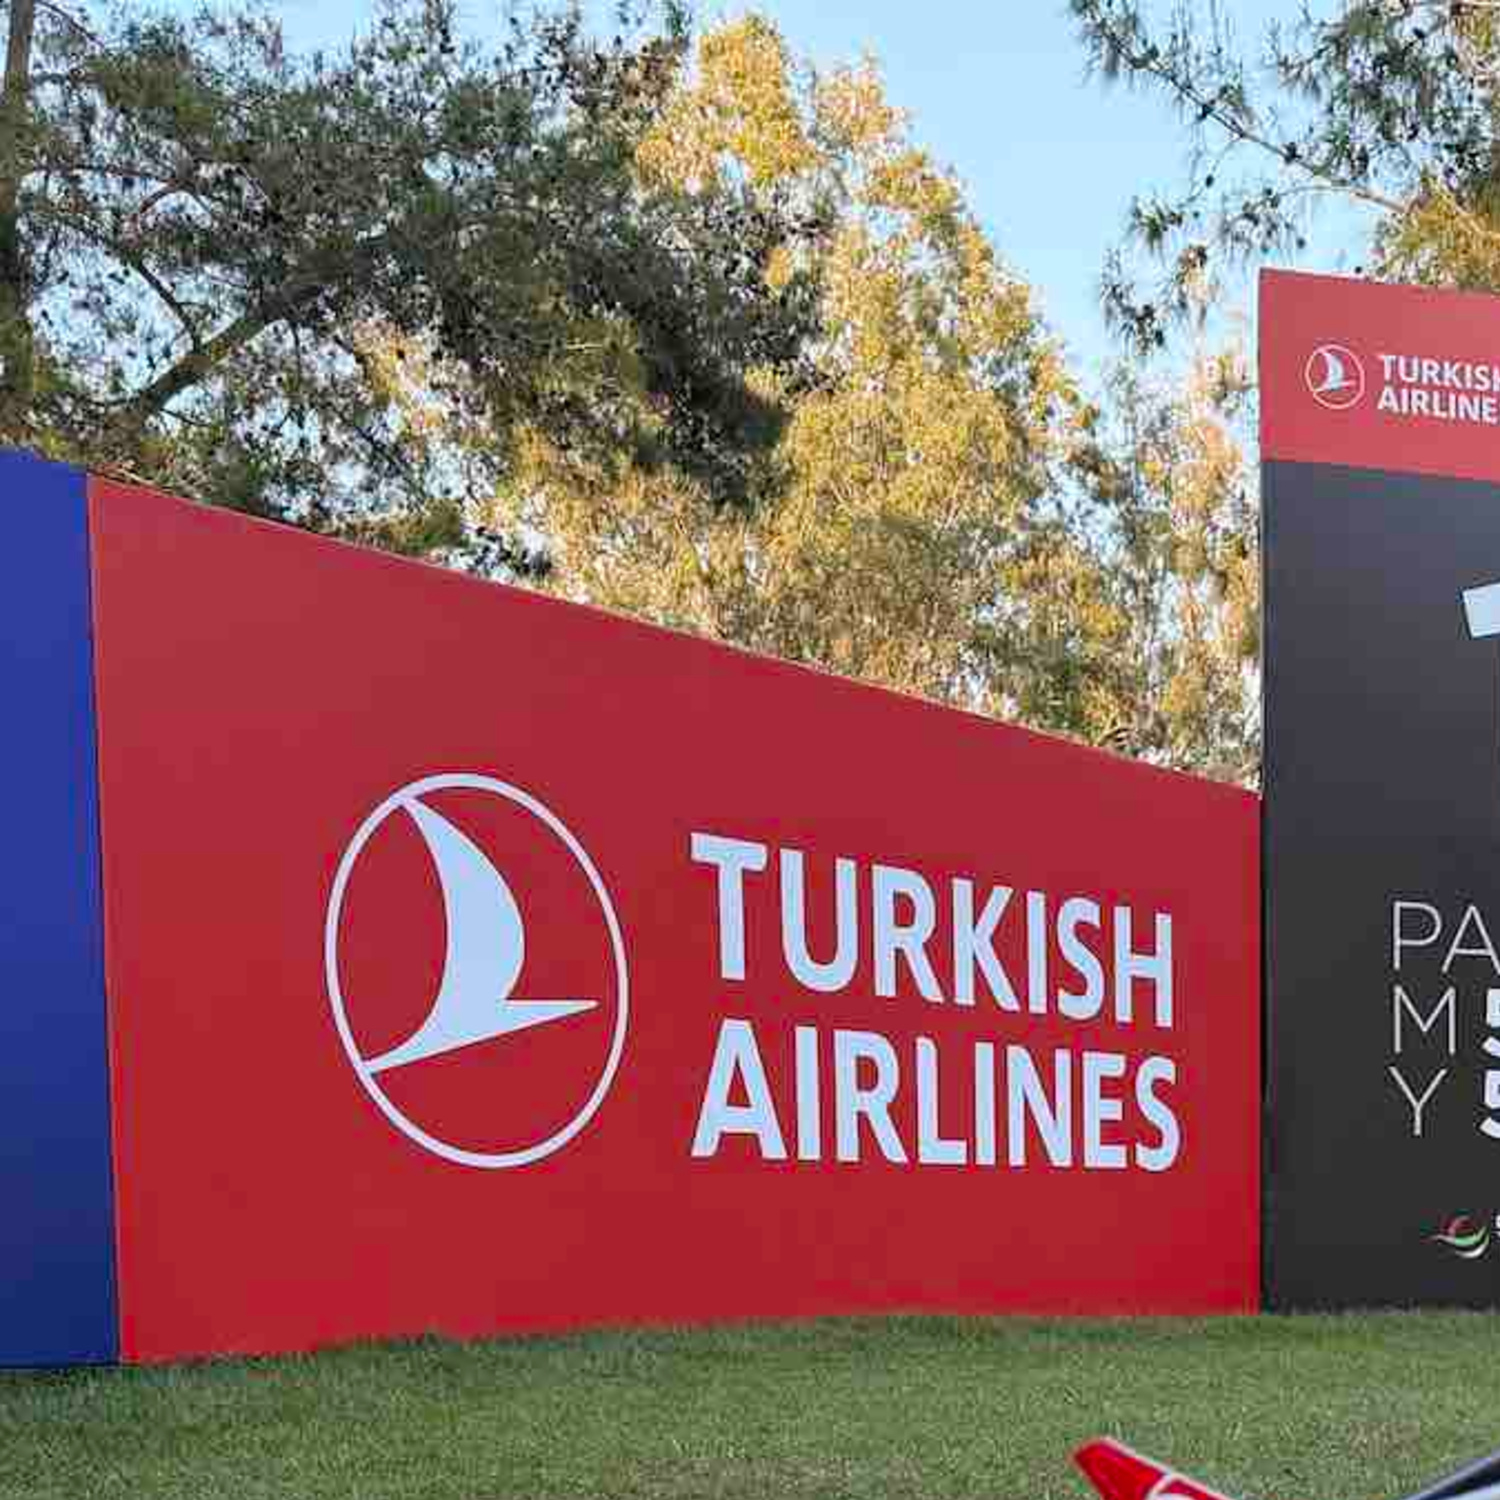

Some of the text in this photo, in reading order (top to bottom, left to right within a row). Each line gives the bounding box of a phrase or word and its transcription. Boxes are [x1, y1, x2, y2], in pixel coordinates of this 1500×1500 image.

[690, 831, 1174, 1029] TURKISH
[1394, 985, 1456, 1055] M
[690, 1017, 1182, 1173] AIRLINES
[1389, 1066, 1448, 1137] Y
